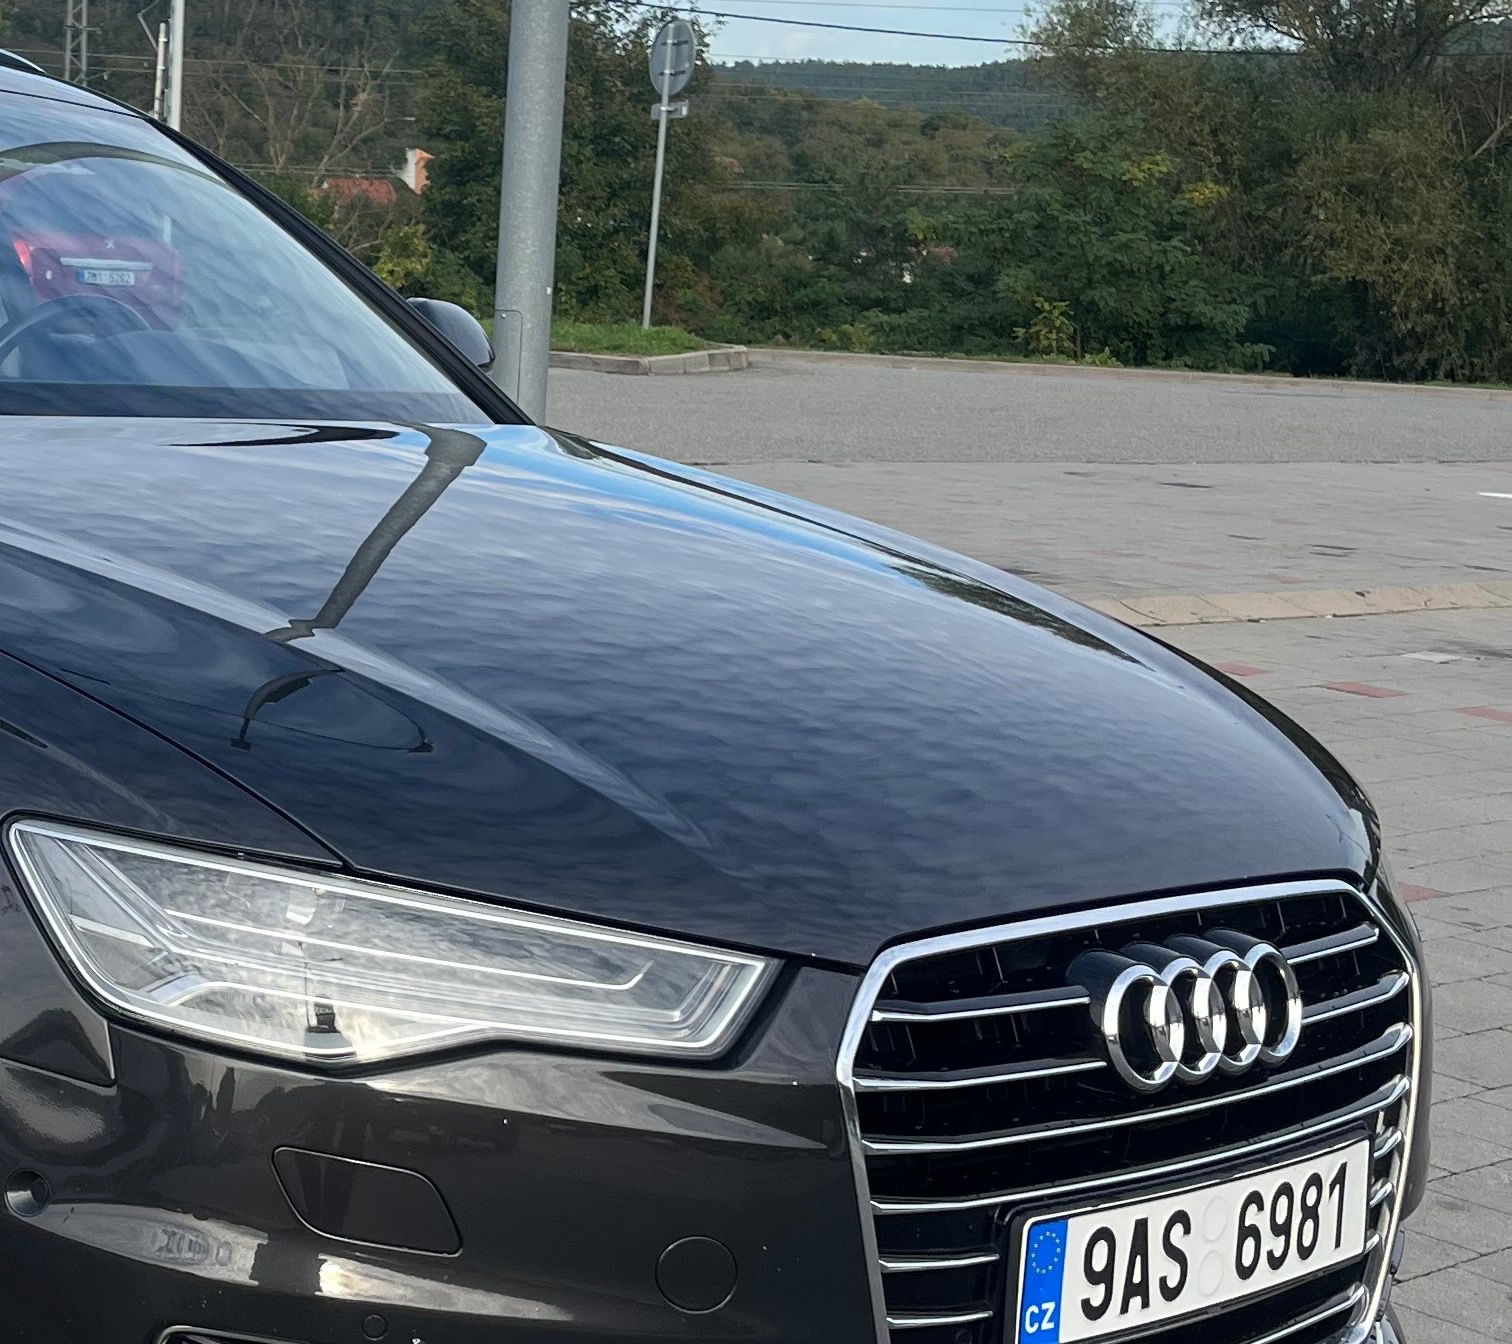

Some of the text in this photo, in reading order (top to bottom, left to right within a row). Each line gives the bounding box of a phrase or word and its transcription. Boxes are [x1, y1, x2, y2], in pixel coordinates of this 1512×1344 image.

[1080, 1161, 1349, 1321] 9AS 6981
[1024, 1301, 1055, 1334] CZ
